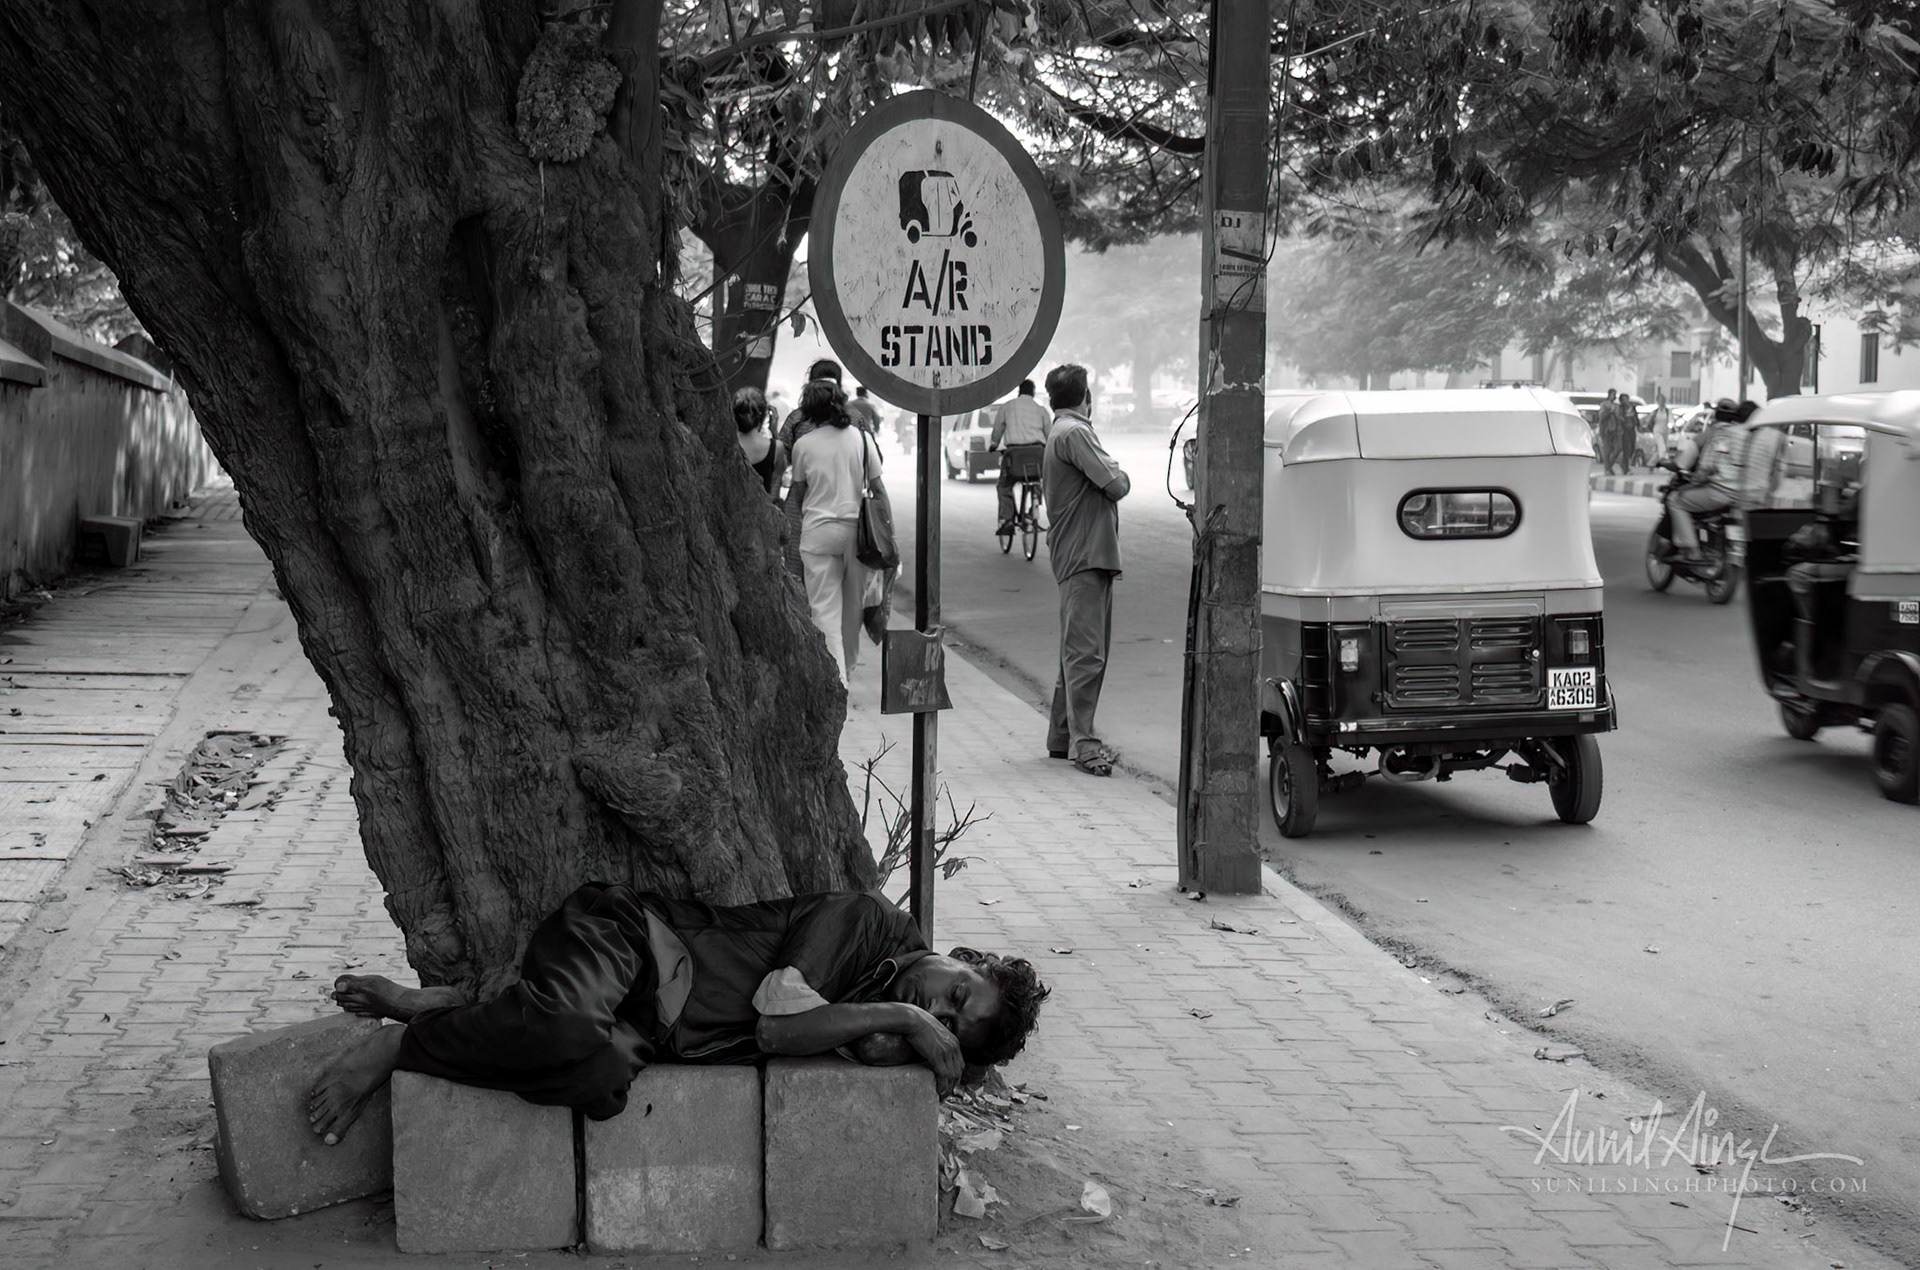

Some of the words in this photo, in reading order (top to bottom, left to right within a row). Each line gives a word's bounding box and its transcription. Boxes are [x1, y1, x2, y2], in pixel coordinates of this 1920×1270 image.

[902, 248, 968, 317] A/R
[881, 325, 993, 368] STAND
[1553, 671, 1591, 688] KA02
[1556, 687, 1594, 706] 6309
